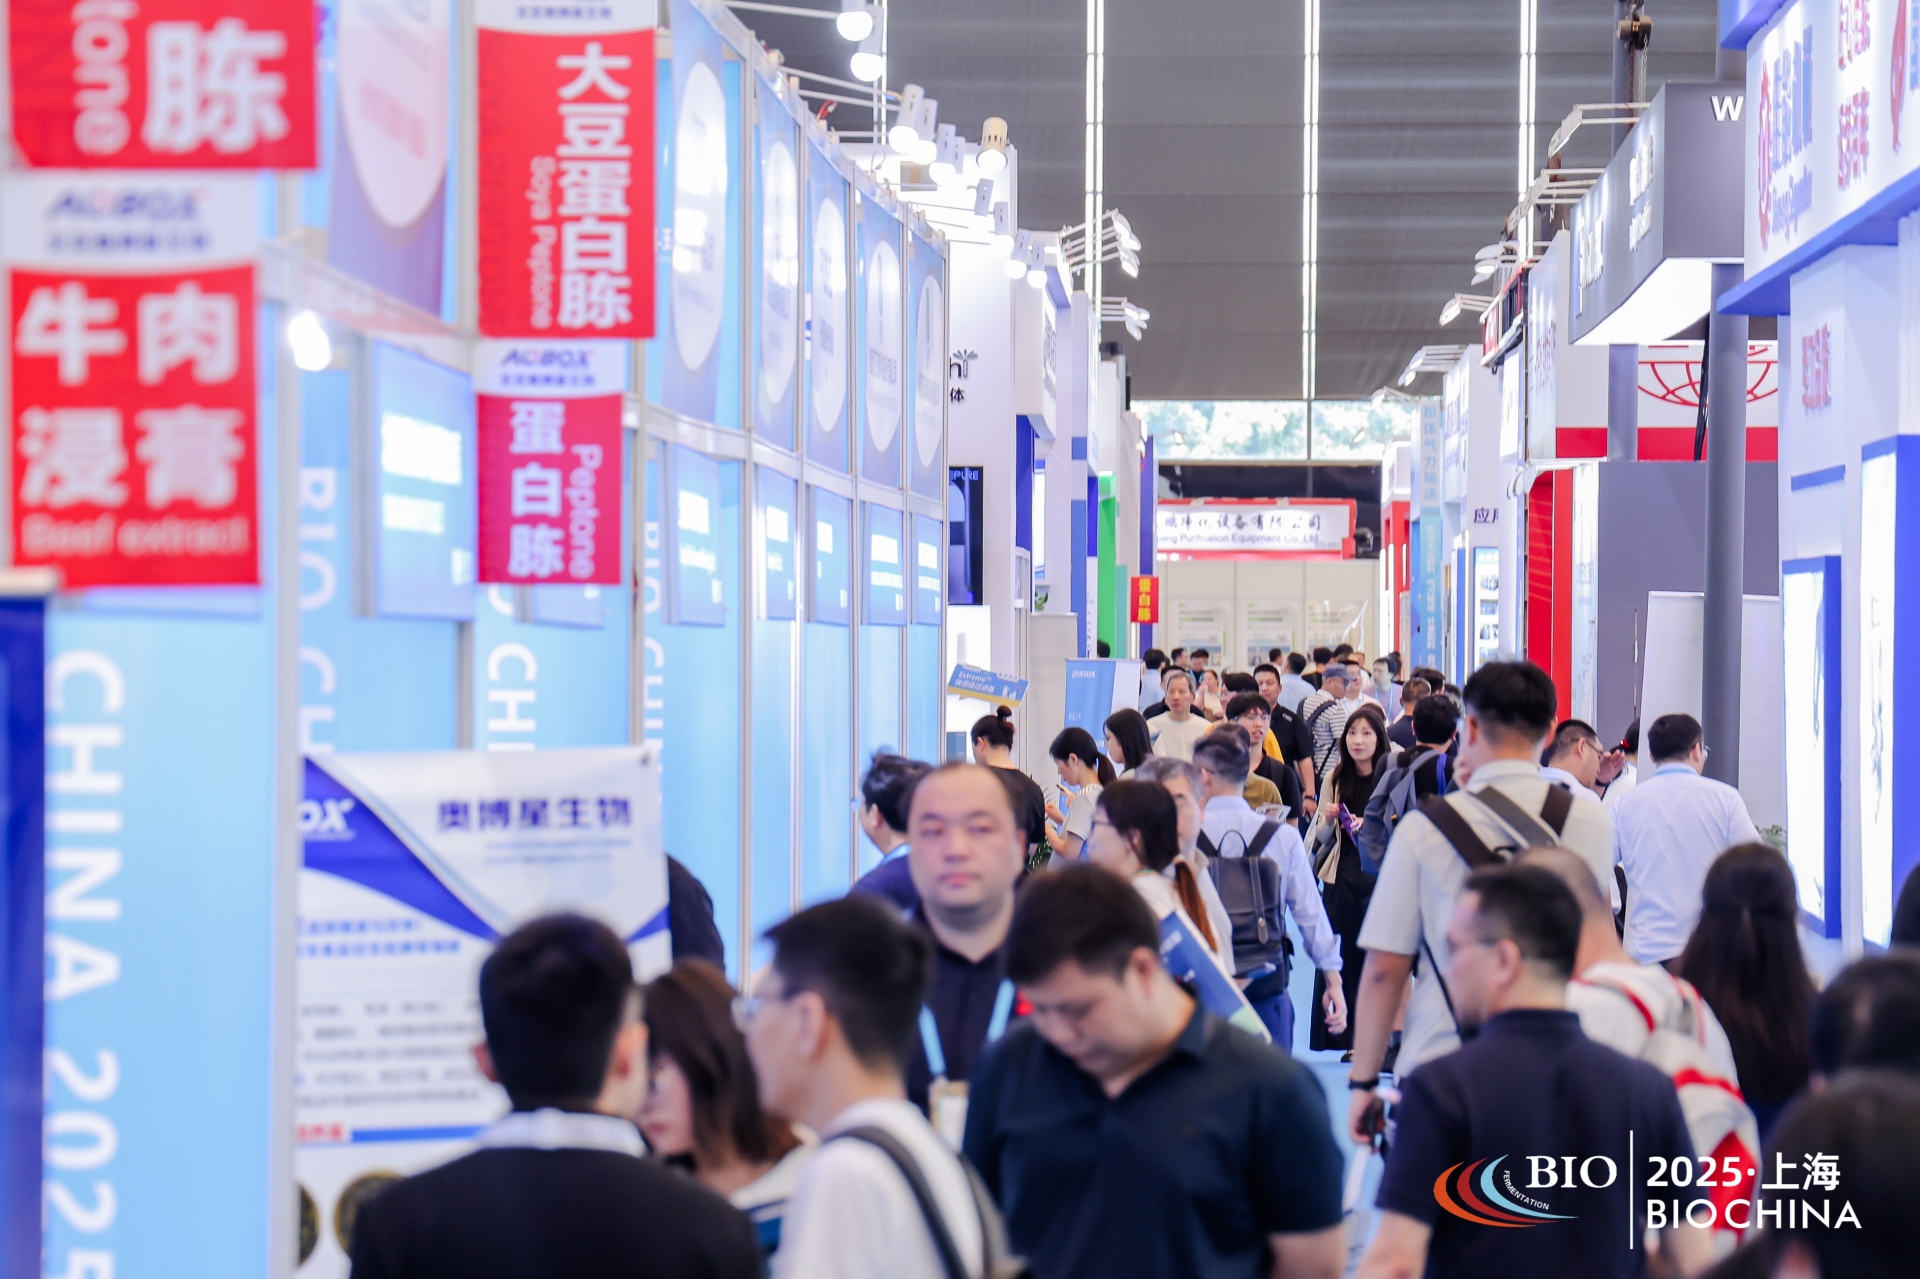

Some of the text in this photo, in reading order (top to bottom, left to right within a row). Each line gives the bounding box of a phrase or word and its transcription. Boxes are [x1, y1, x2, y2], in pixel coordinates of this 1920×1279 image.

[556, 41, 633, 329] 大豆蛋白胨
[15, 280, 241, 387] 牛肉
[508, 401, 566, 578] 蛋白胨
[564, 444, 604, 579] Peptone
[45, 649, 125, 1000] CHINA
